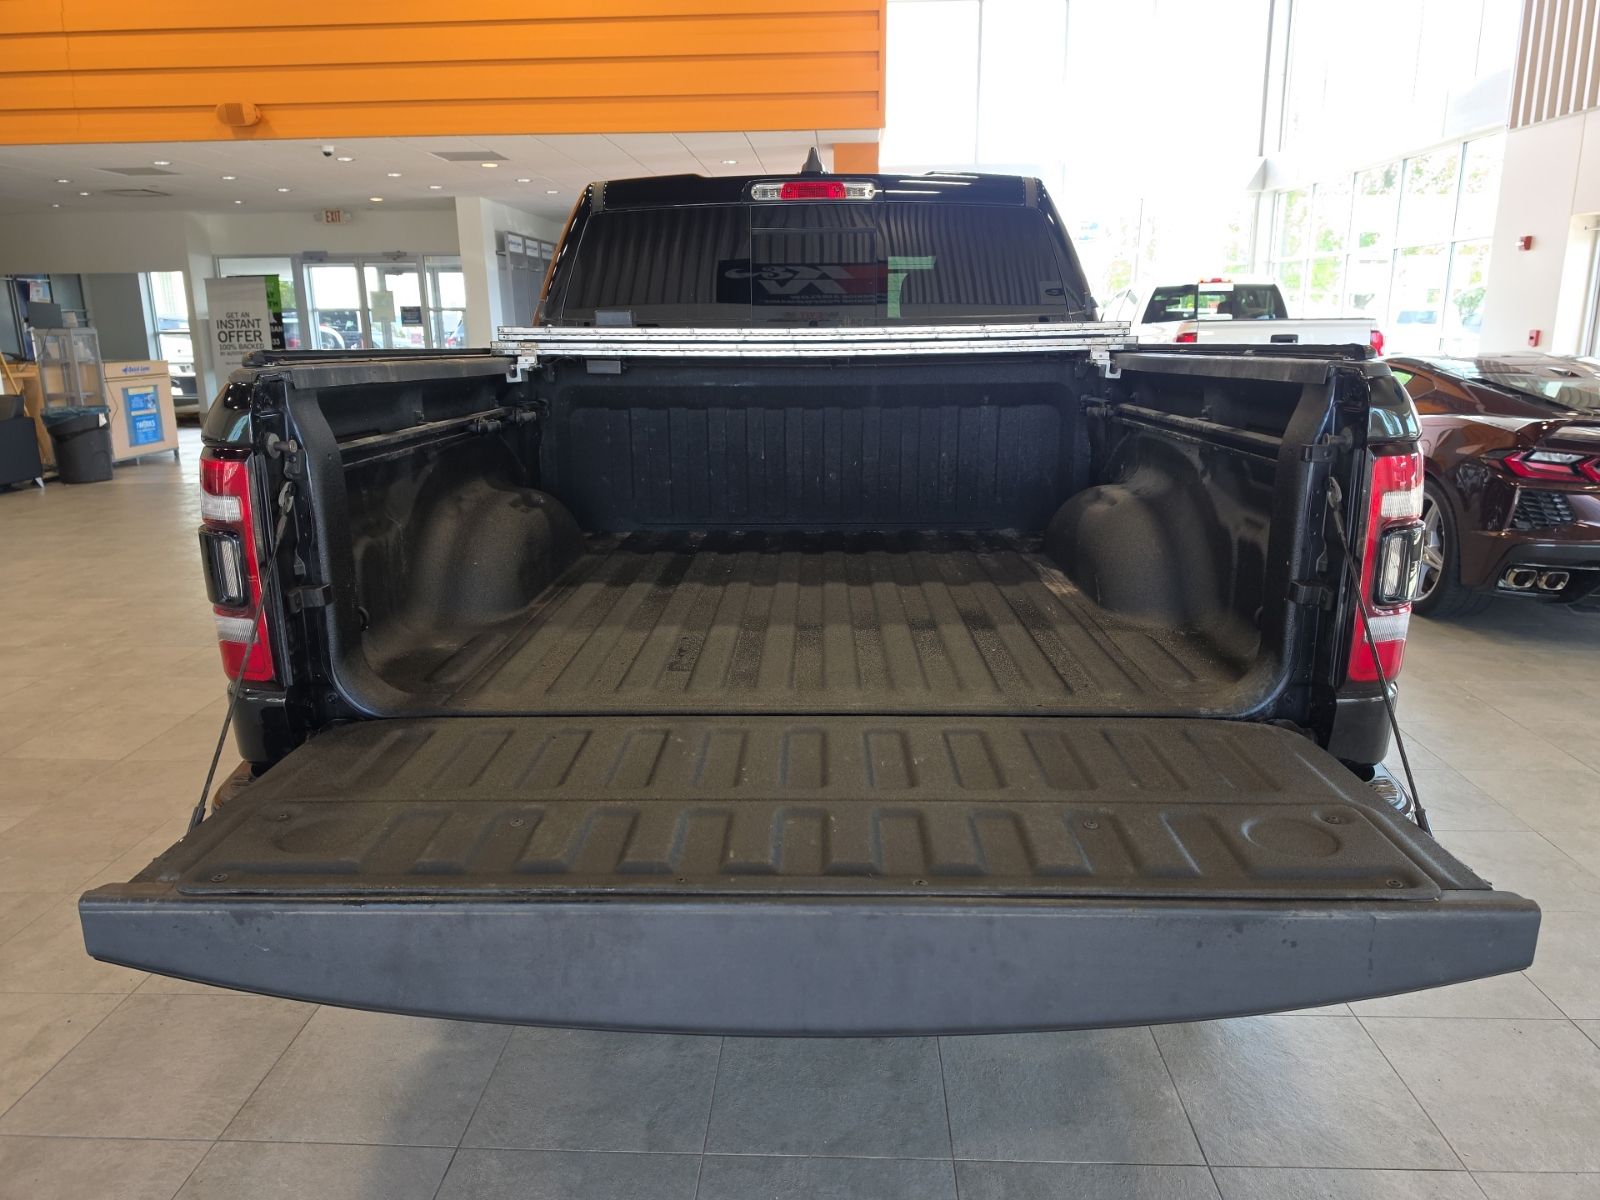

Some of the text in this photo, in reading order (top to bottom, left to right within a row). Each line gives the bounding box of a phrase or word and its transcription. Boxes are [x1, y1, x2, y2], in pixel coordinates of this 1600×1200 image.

[325, 210, 341, 223] EXIT
[216, 319, 261, 329] INSTANT
[217, 330, 263, 343] OFFER
[219, 343, 237, 351] 100%
